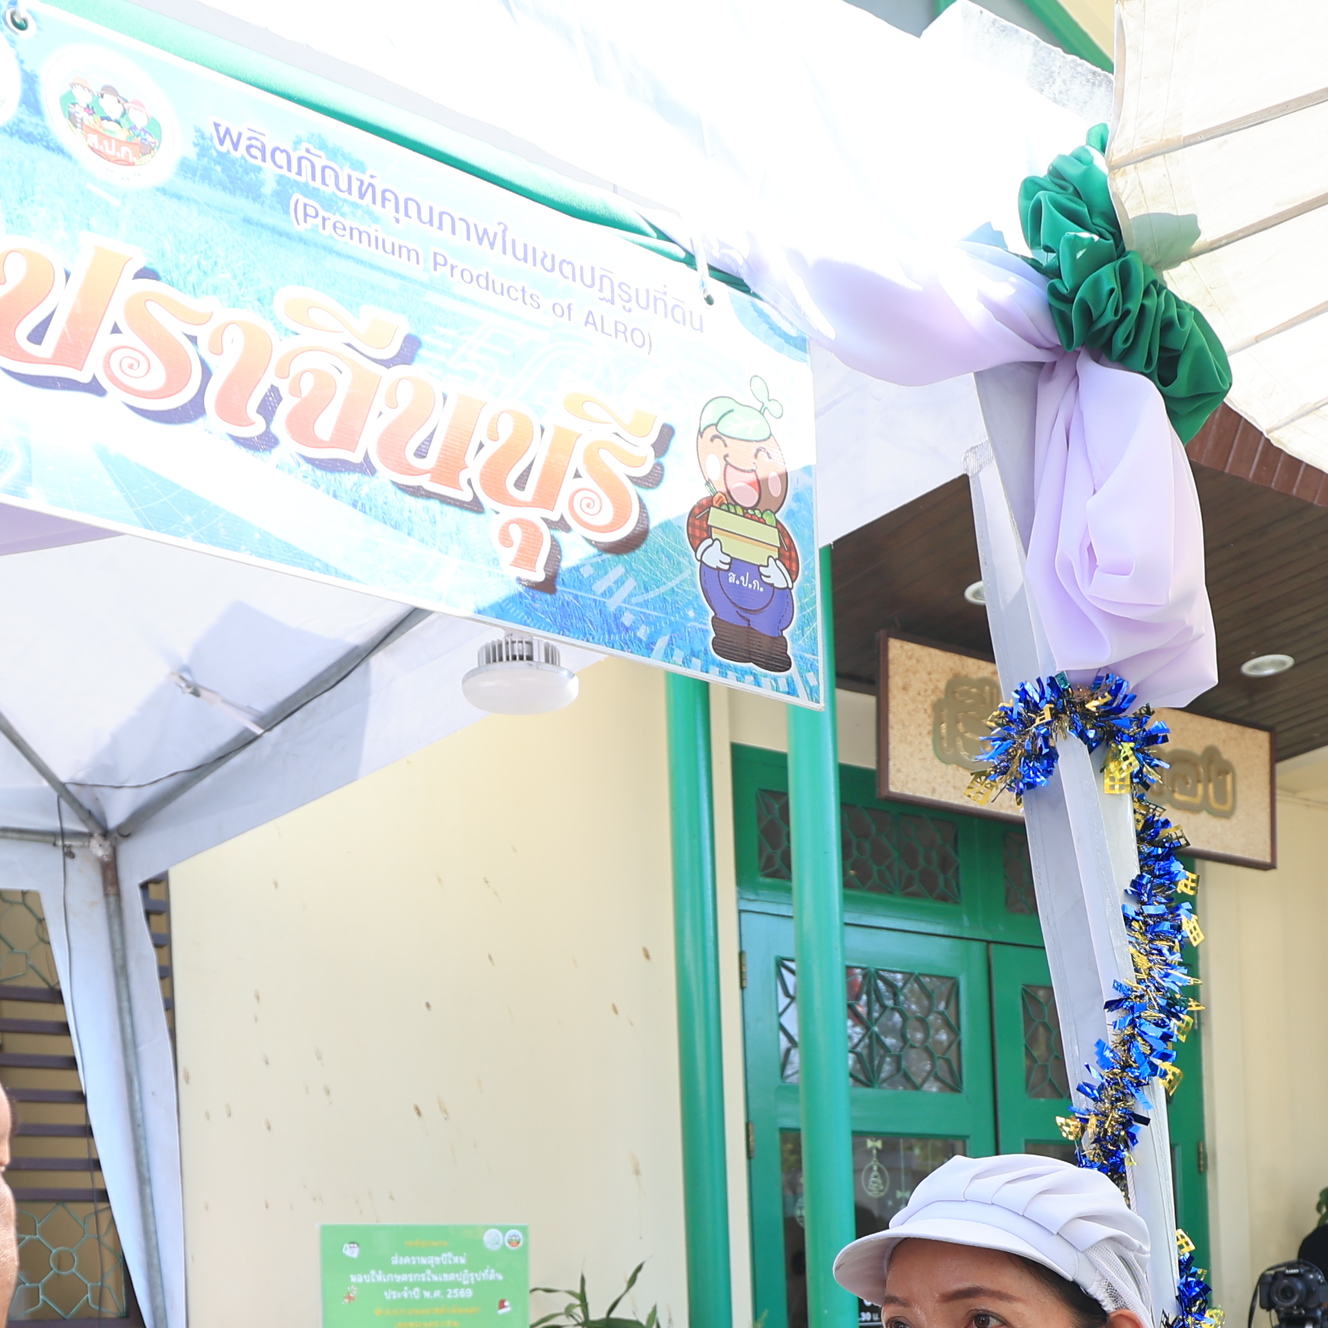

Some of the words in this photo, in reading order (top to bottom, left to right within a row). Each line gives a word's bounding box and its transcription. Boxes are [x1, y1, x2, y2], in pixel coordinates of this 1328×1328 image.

[212, 120, 705, 334] ผลิตภัณฑ์คุณภาพในเขตปฏิรูปที่ดิน
[292, 197, 422, 266] (Premium
[431, 250, 543, 311] Products
[551, 301, 573, 322] of
[583, 309, 654, 356] ALRO)
[727, 571, 765, 593] ส.ป.ก.
[446, 1287, 473, 1299] 2569
